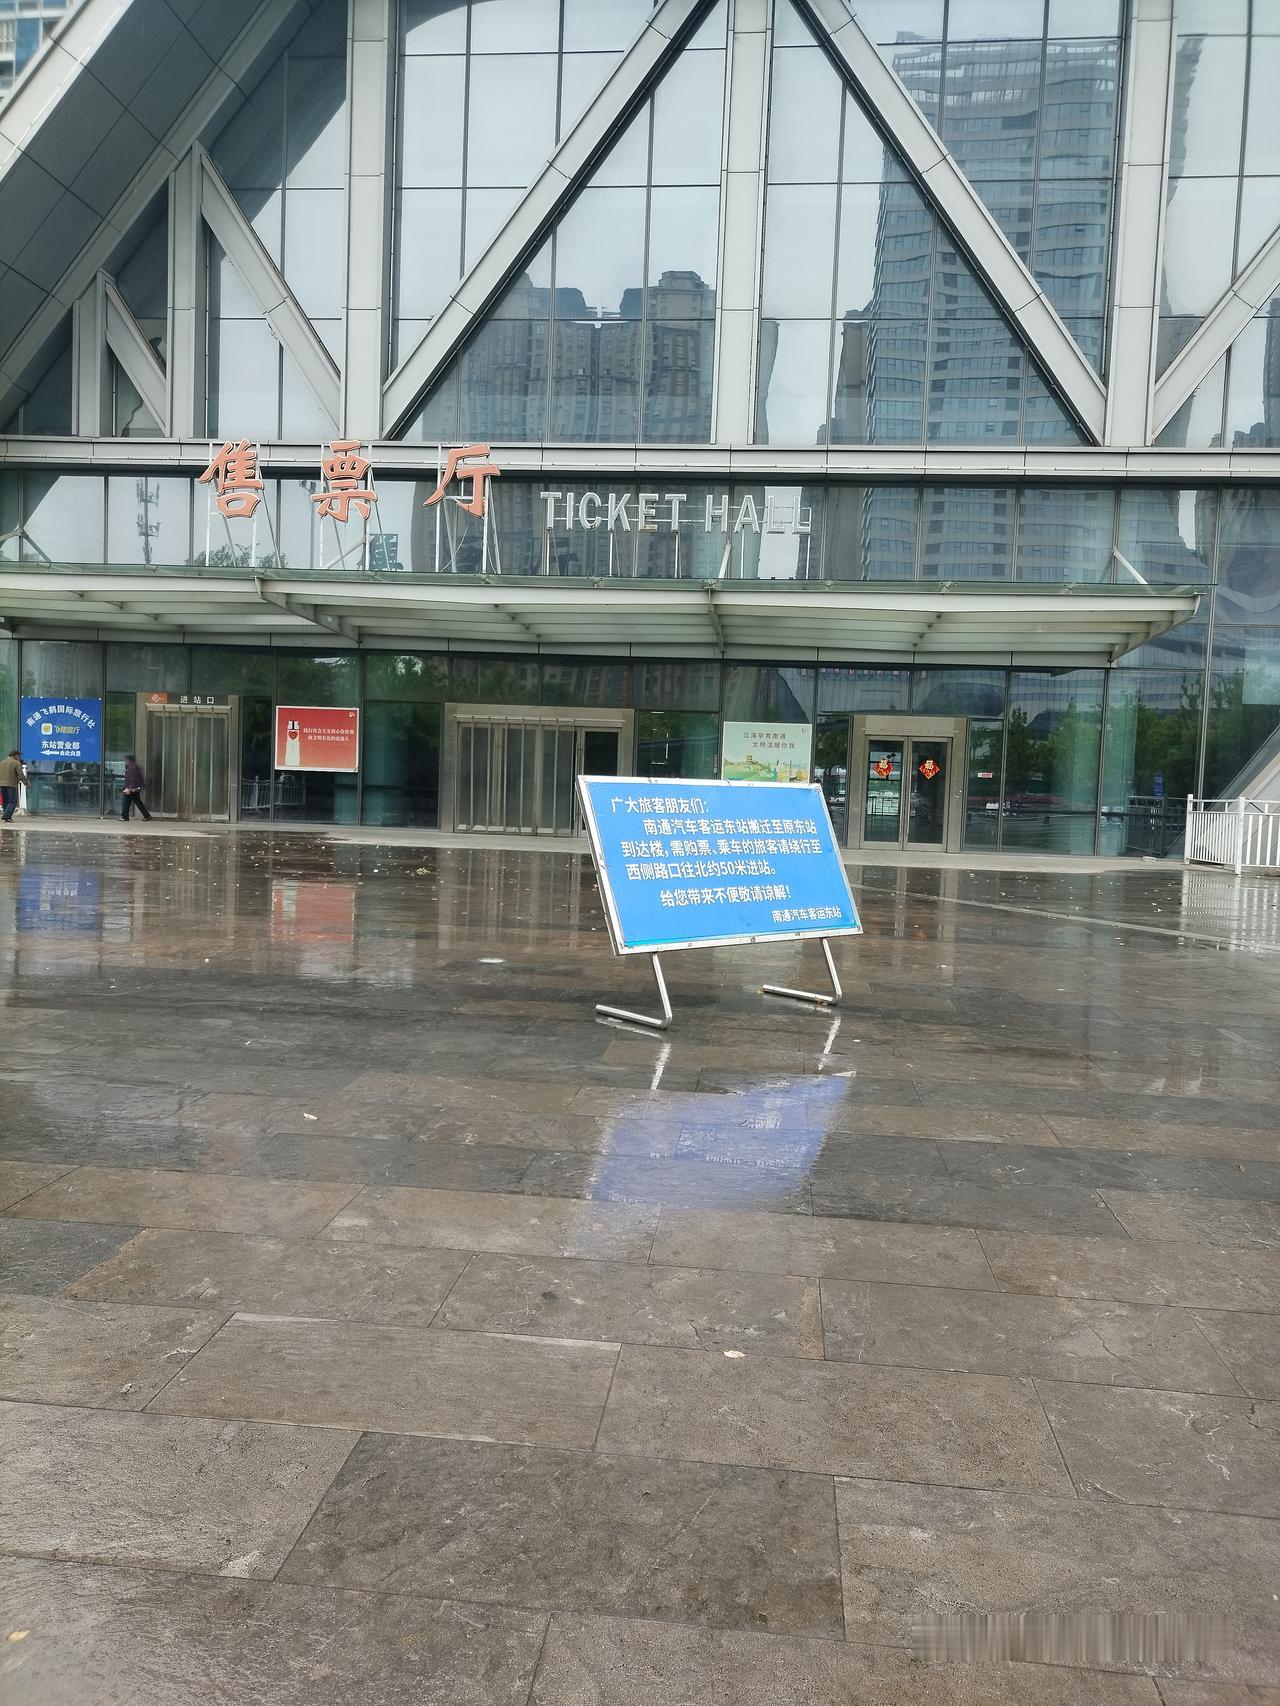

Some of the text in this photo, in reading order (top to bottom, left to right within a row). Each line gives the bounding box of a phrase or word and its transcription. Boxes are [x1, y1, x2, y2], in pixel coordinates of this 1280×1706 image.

[198, 438, 501, 523] 售票厅
[540, 491, 812, 535] TICKET HALL
[180, 695, 215, 705] 进站口
[41, 740, 81, 750] 东站营业部
[643, 818, 817, 836] 南通汽车客运东站搬迁至原东站
[625, 859, 776, 881] 西侧路口往北约50米进站。
[772, 906, 842, 923] 南通汽车客运东站
